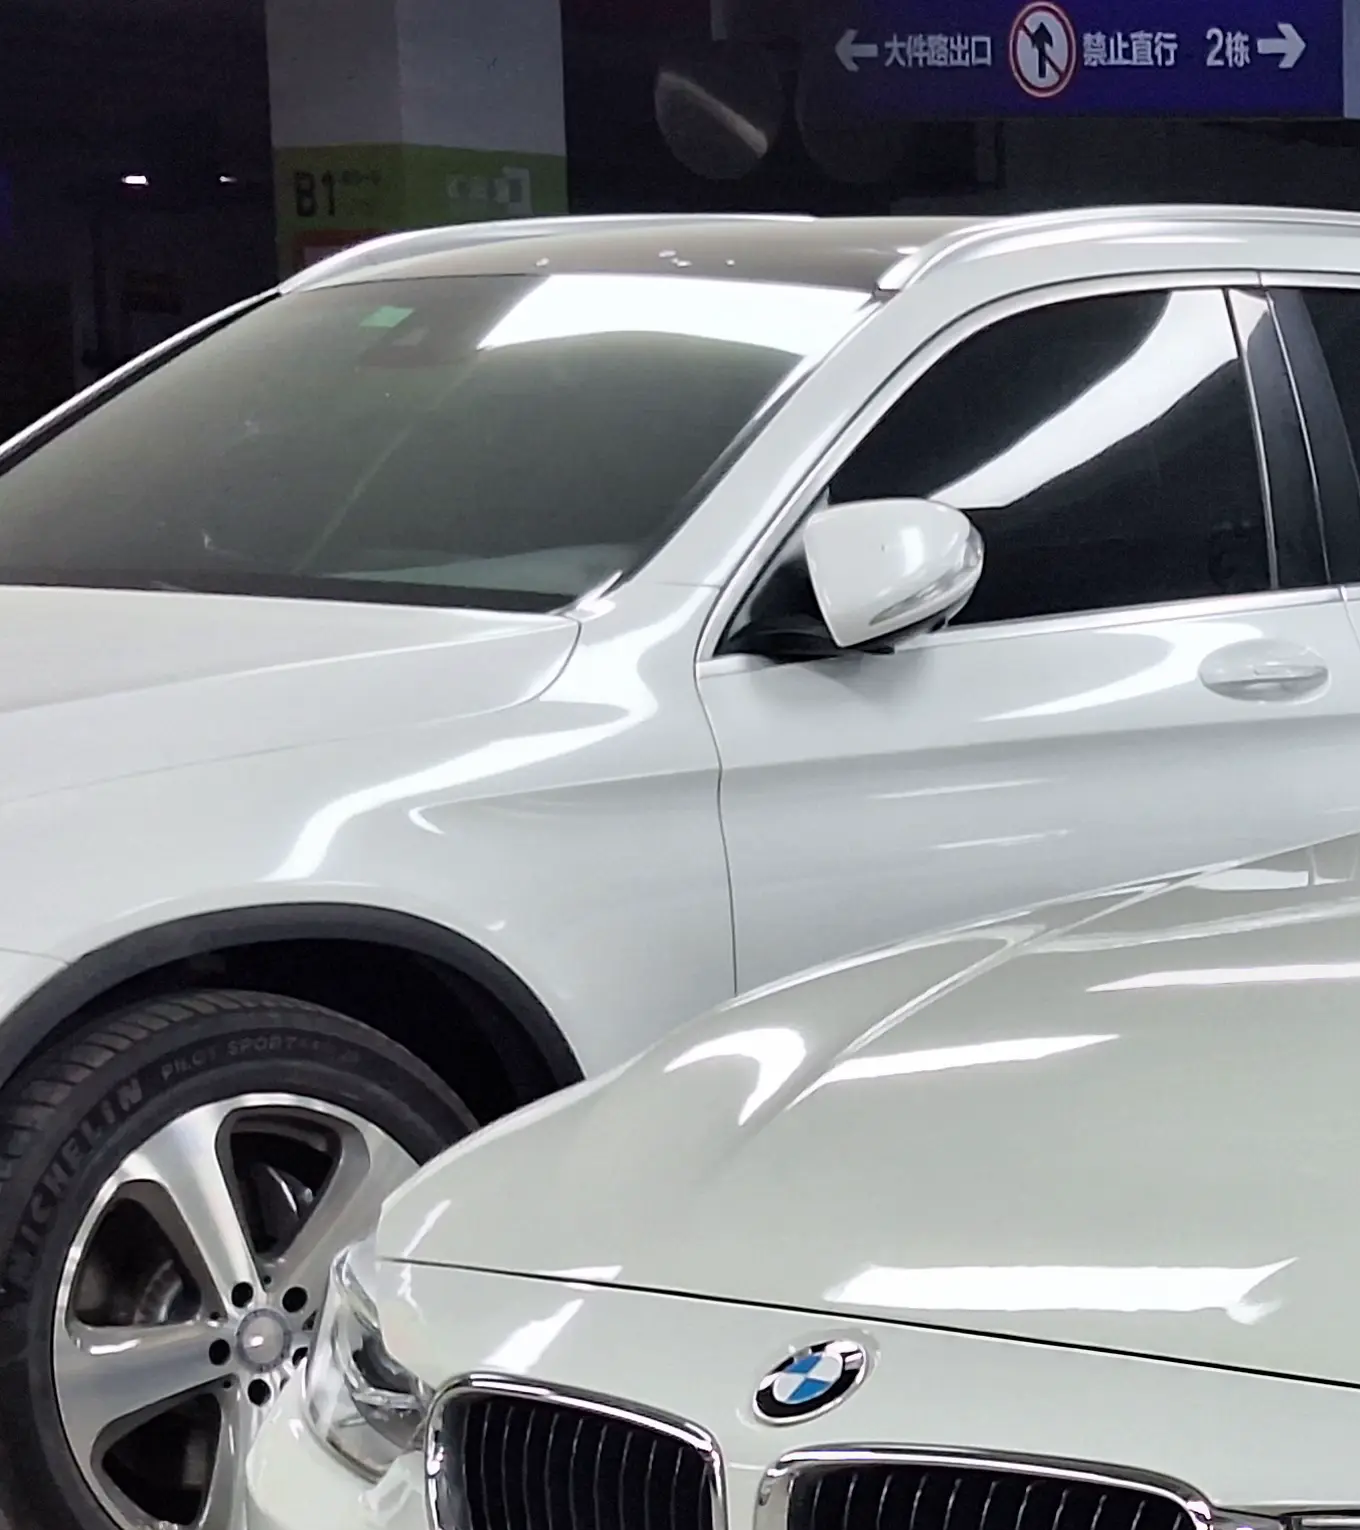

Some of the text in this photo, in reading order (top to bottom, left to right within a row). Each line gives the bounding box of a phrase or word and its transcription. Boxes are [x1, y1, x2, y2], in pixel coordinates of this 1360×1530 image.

[1082, 30, 1178, 67] 禁止直行
[1205, 27, 1251, 68] 2栋
